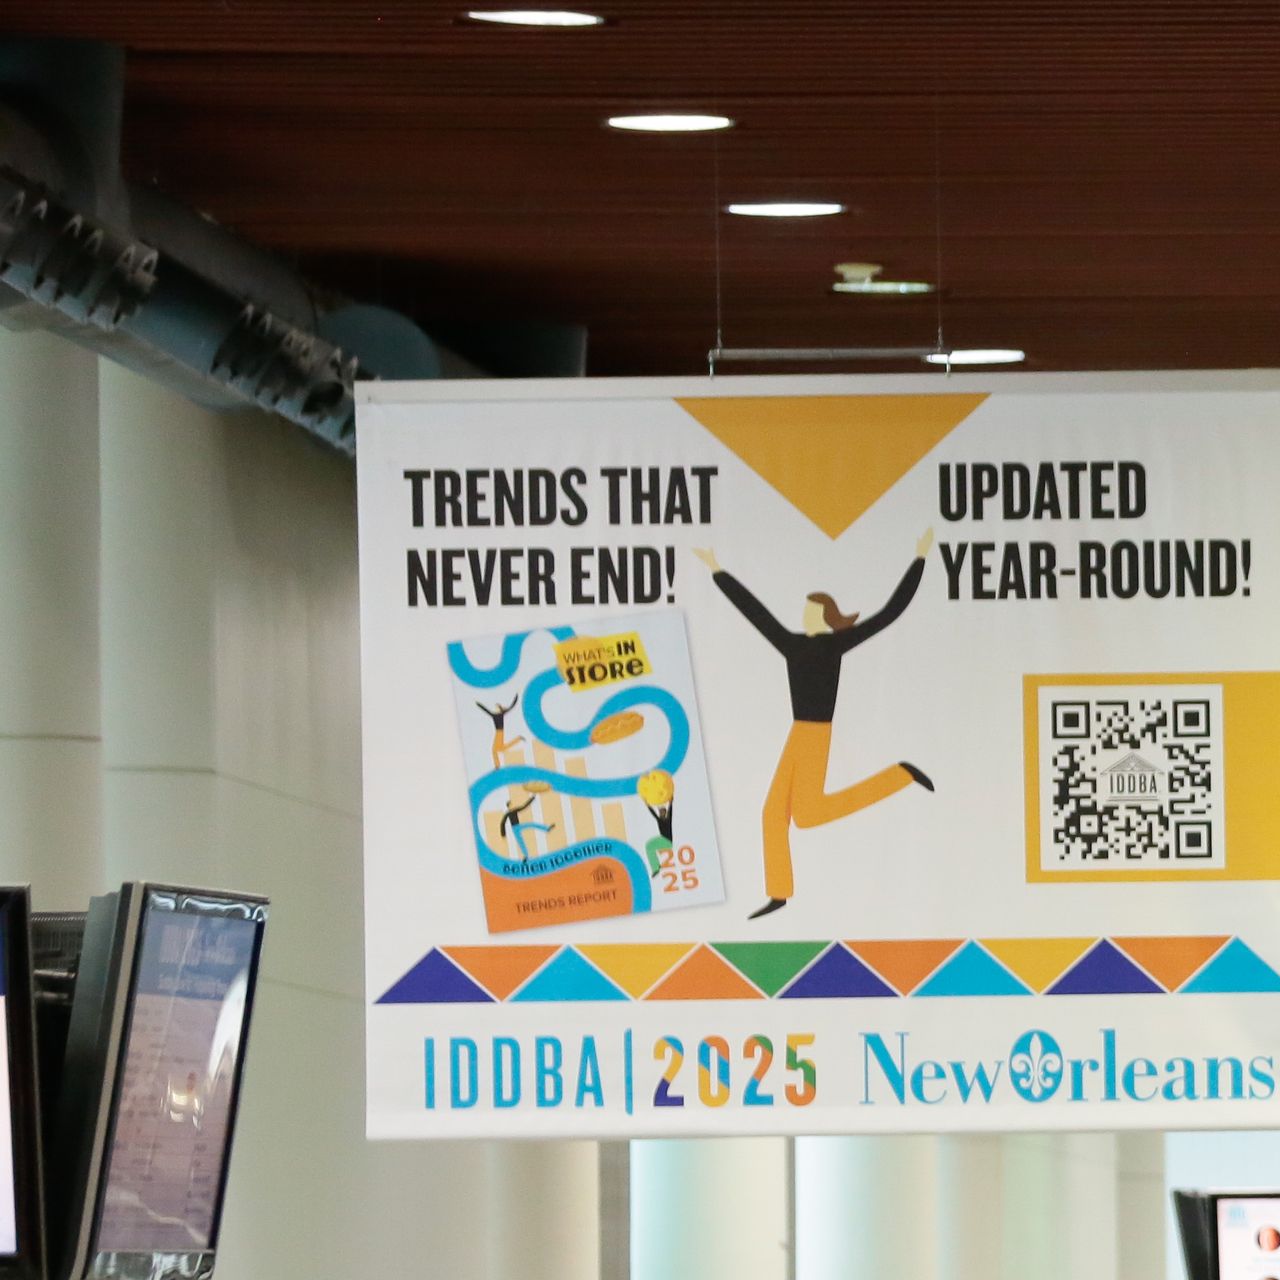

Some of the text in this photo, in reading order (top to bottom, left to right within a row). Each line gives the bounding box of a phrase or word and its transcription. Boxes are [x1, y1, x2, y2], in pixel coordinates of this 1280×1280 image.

[404, 466, 718, 530] TRENDS THAT
[938, 460, 1146, 520] UPDATED
[405, 546, 676, 608] NEVER END!
[937, 539, 1252, 601] YEAR-ROUND!
[616, 640, 636, 656] IN
[1110, 773, 1157, 794] IDDBA
[658, 845, 696, 868] 20
[515, 888, 619, 914] TRENDS REPORT
[662, 869, 699, 892] 25
[424, 1035, 604, 1110] IDDBA
[652, 1033, 816, 1107] 2025
